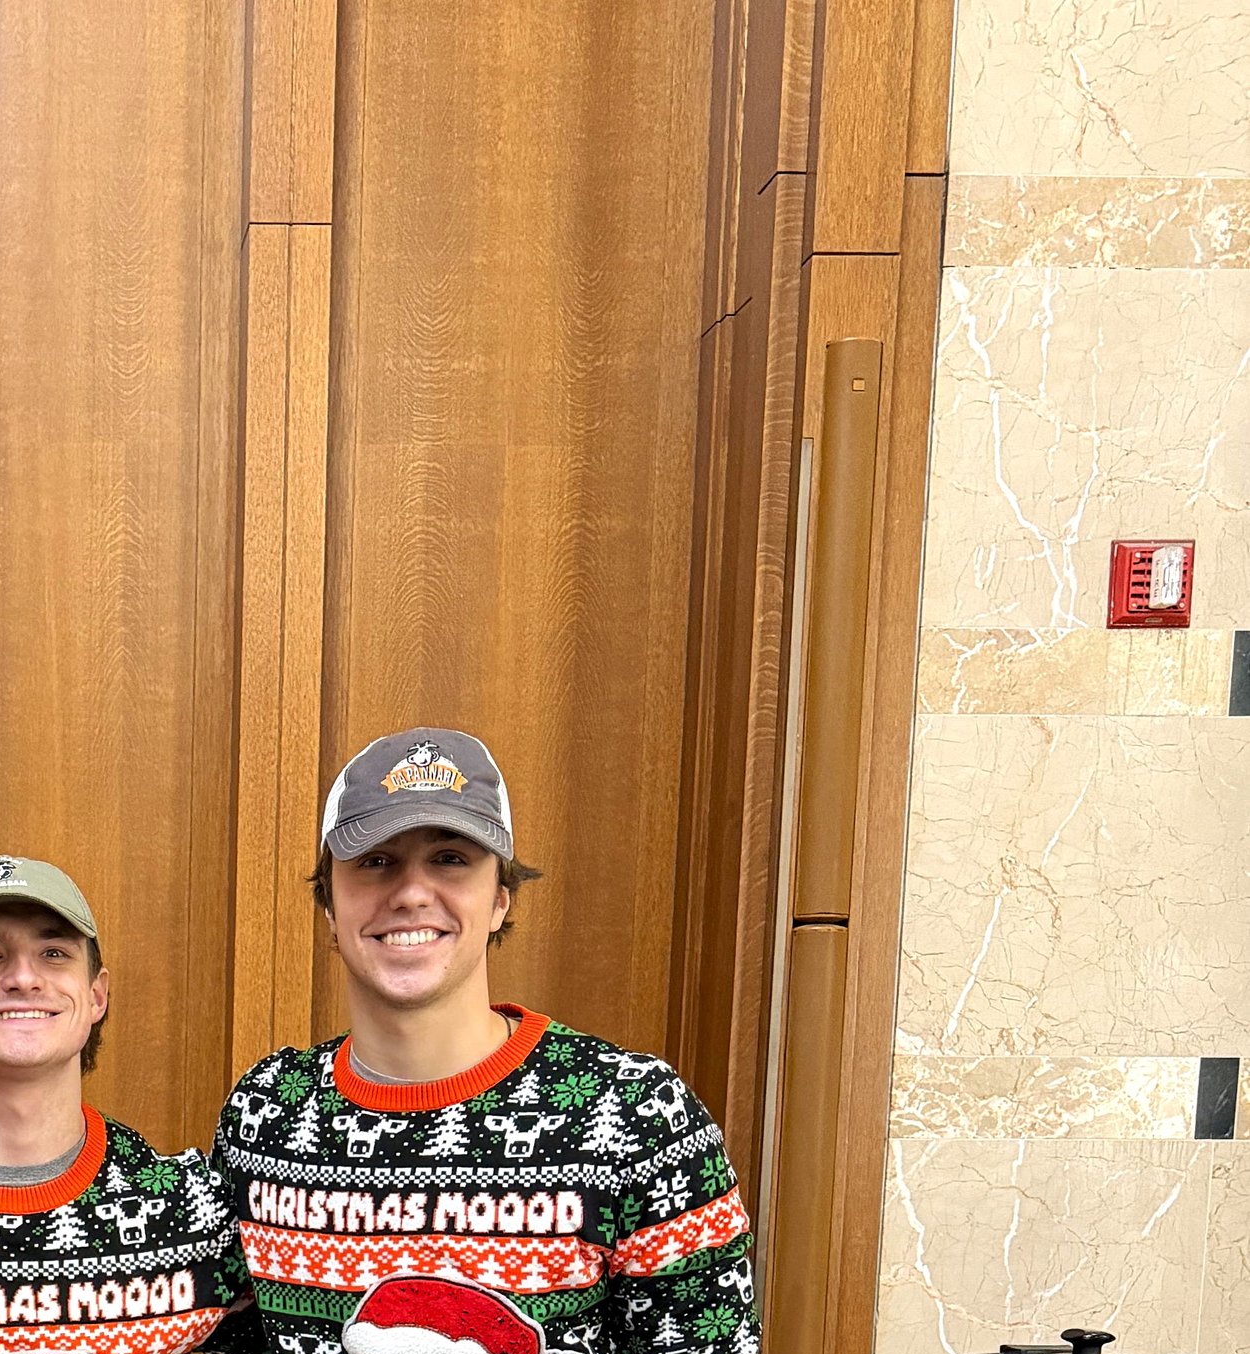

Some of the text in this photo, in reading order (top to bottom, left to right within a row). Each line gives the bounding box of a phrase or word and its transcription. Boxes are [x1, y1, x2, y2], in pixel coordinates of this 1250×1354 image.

[249, 1180, 583, 1235] CHRISTMAS MOOOD
[68, 1268, 196, 1322] MOOOD
